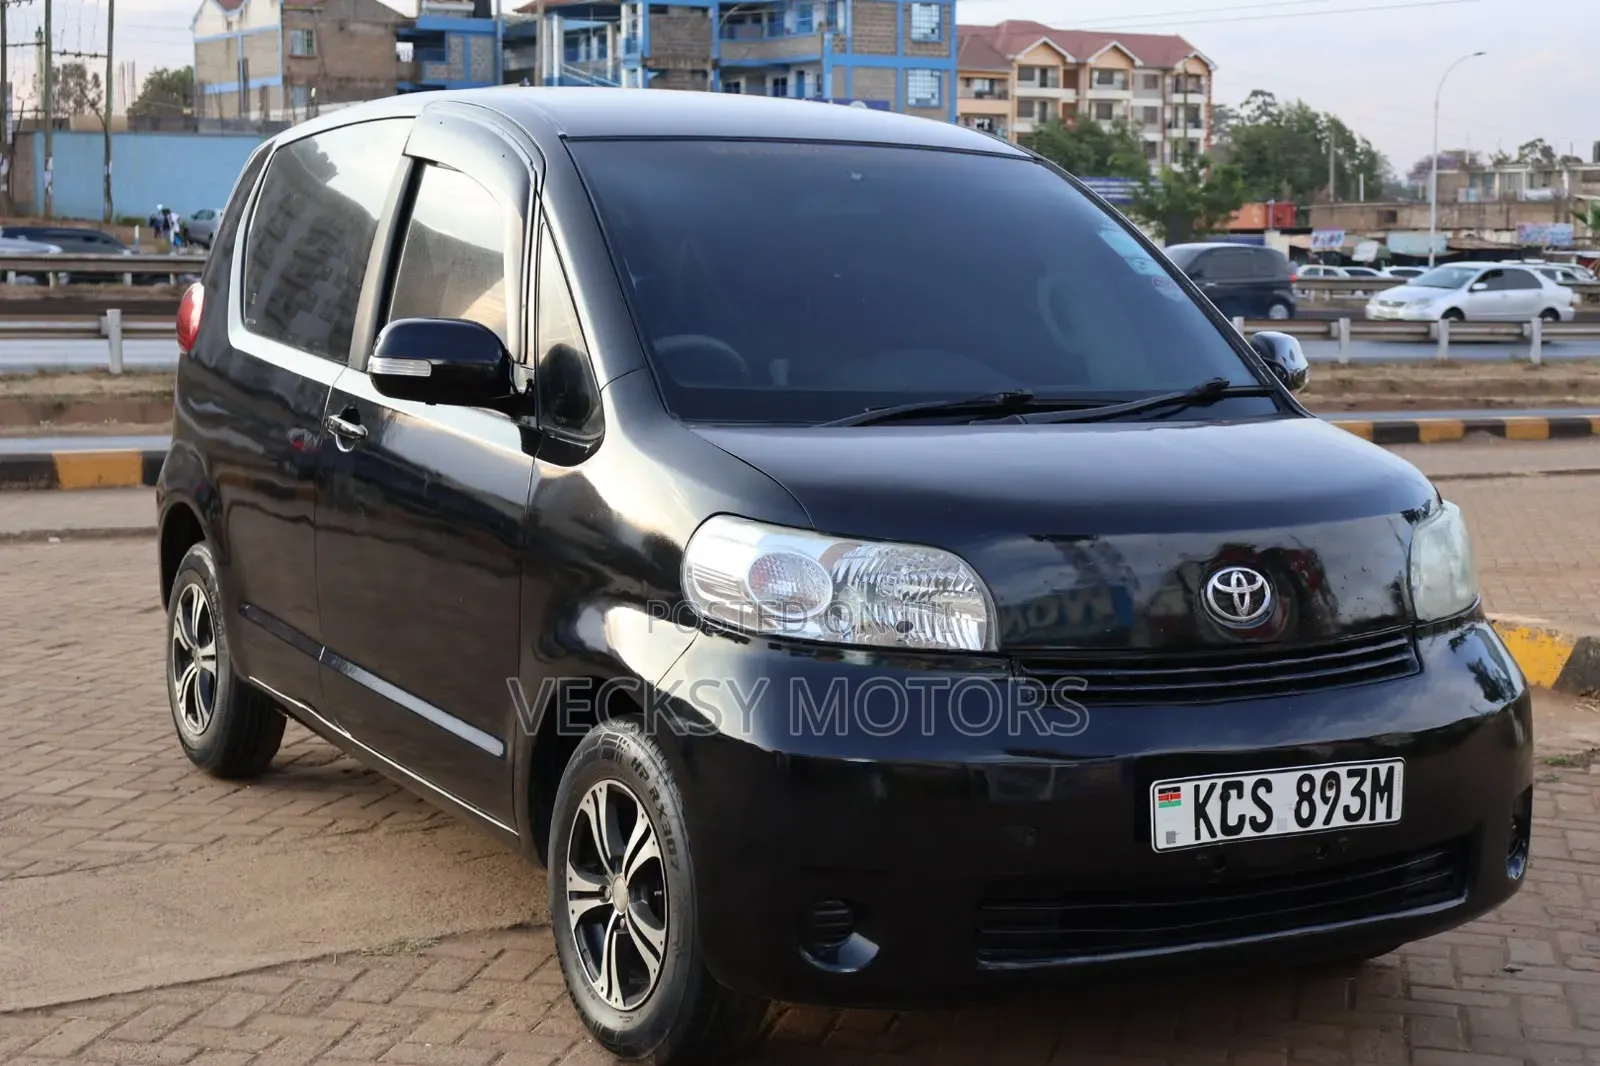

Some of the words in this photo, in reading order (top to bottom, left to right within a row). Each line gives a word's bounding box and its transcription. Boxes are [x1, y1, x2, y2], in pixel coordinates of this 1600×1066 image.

[630, 757, 650, 782] HP
[1193, 778, 1274, 840] KCS
[1294, 765, 1395, 828] 893M
